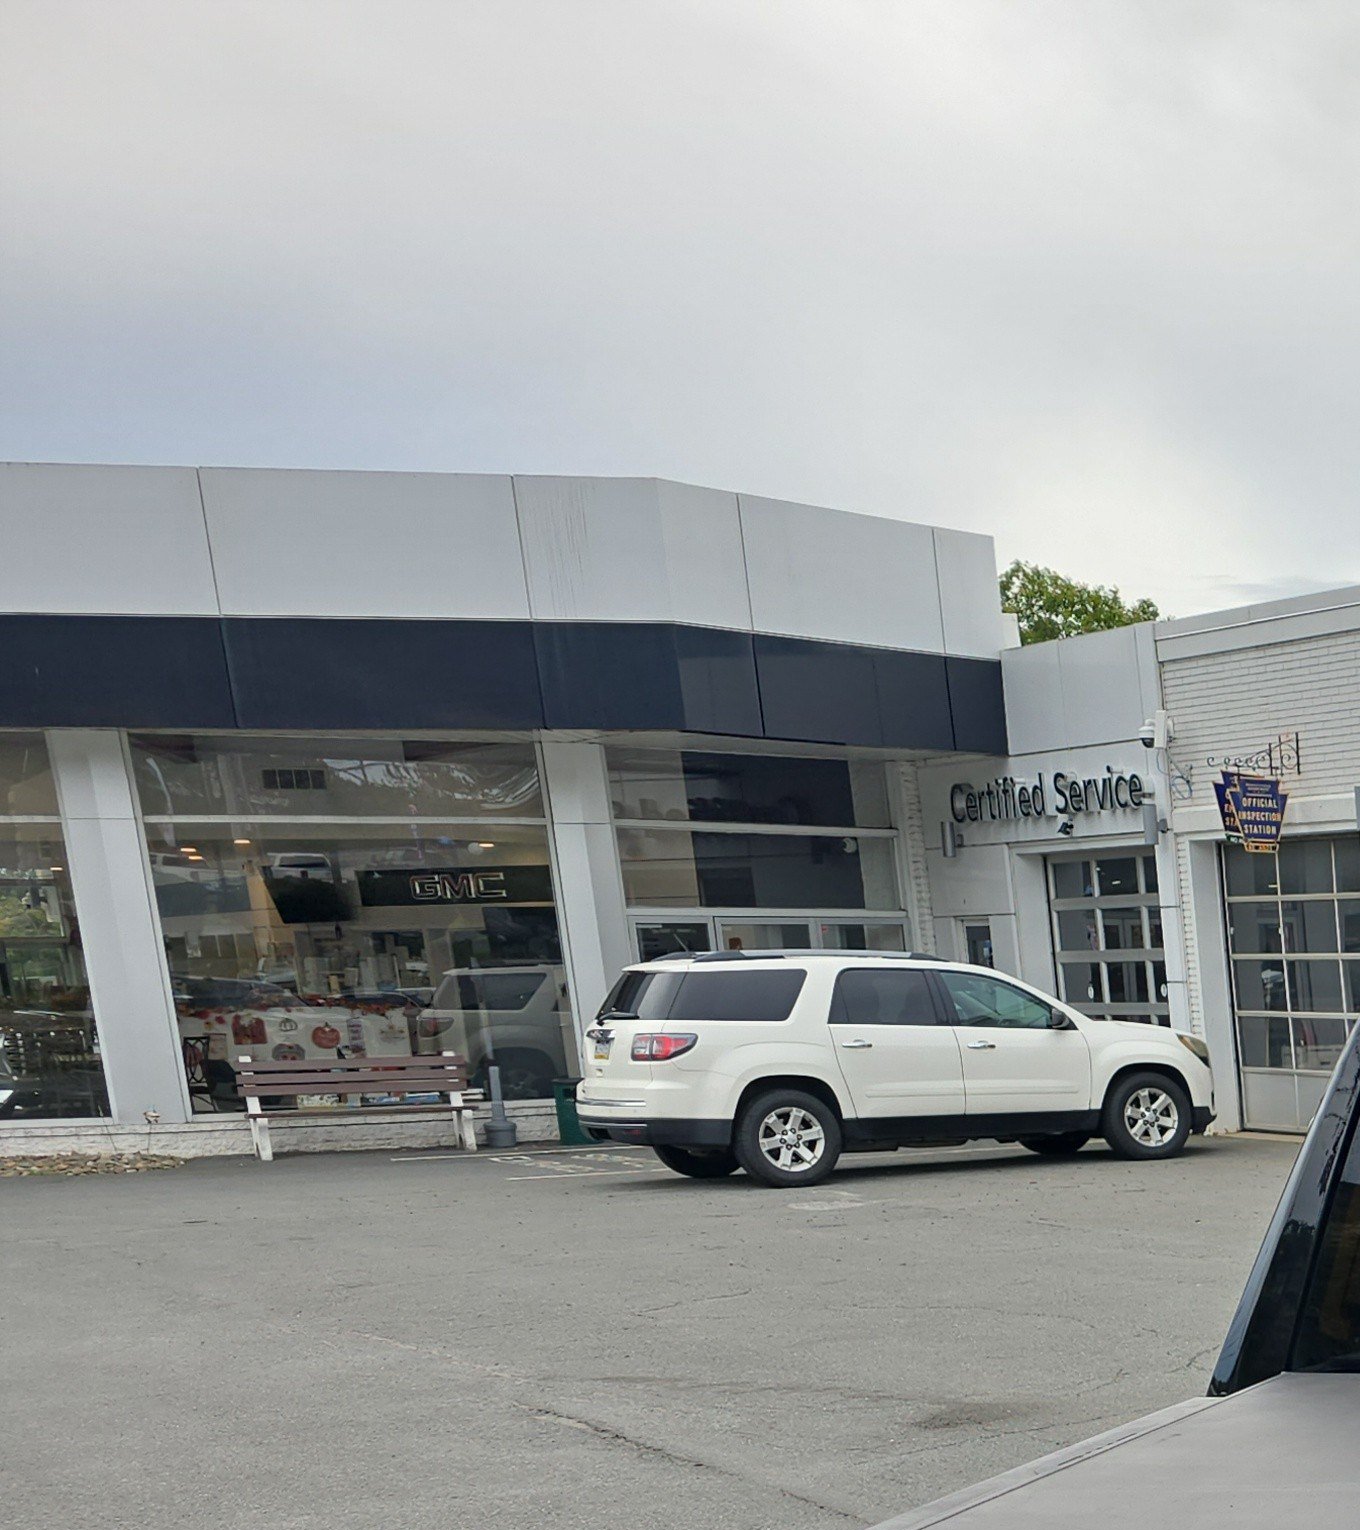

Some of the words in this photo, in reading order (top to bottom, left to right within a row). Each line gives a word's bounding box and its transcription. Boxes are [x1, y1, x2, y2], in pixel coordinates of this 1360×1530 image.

[951, 773, 1045, 823] Certified
[1053, 766, 1144, 814] Service
[1242, 797, 1277, 808] OFFICIAL
[1238, 811, 1281, 821] INSPECTION
[1244, 824, 1276, 834] STATION
[411, 872, 507, 899] GMC
